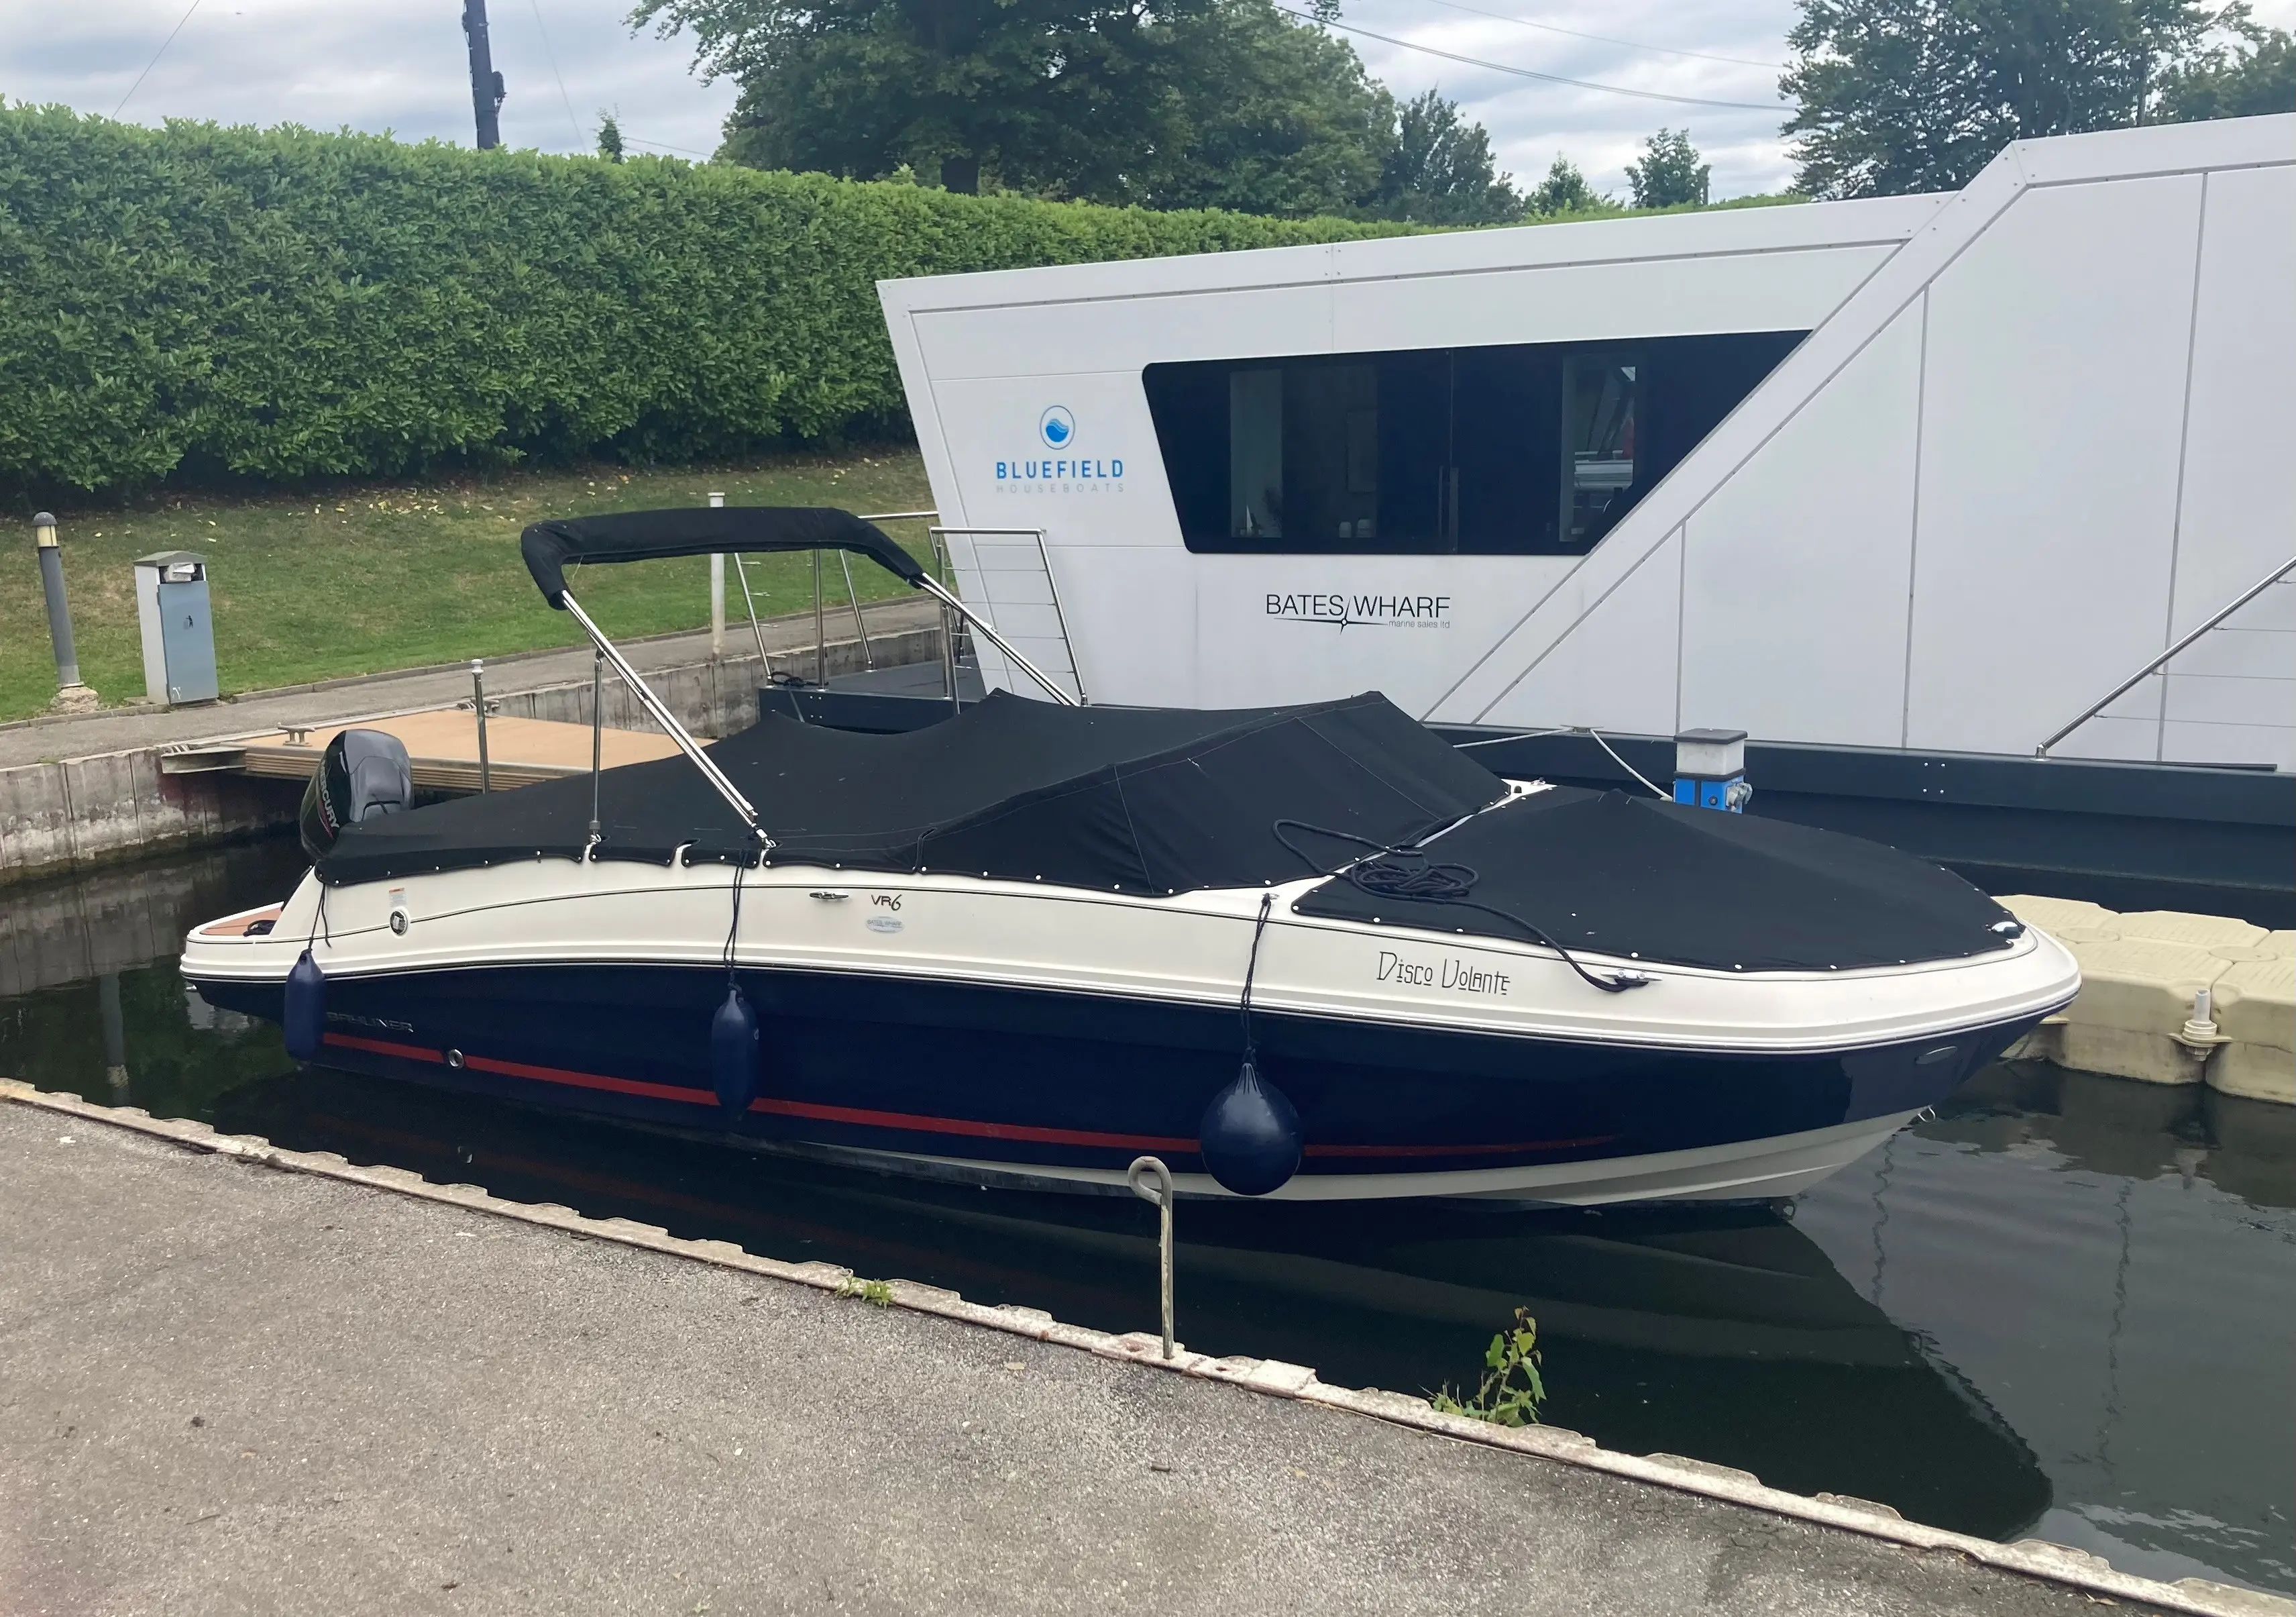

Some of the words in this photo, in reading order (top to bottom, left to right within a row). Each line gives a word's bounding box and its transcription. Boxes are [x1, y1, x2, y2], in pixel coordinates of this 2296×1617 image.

[996, 460, 1124, 479] BLUEFIELD
[996, 482, 1124, 493] HOUSEBOATS
[1266, 594, 1344, 616] BATES
[1354, 595, 1451, 618] WHARF
[1388, 619, 1415, 628] marine
[1417, 620, 1438, 629] sales
[1440, 620, 1450, 629] ltd
[319, 760, 340, 829] MERCURY
[871, 894, 903, 911] VR6
